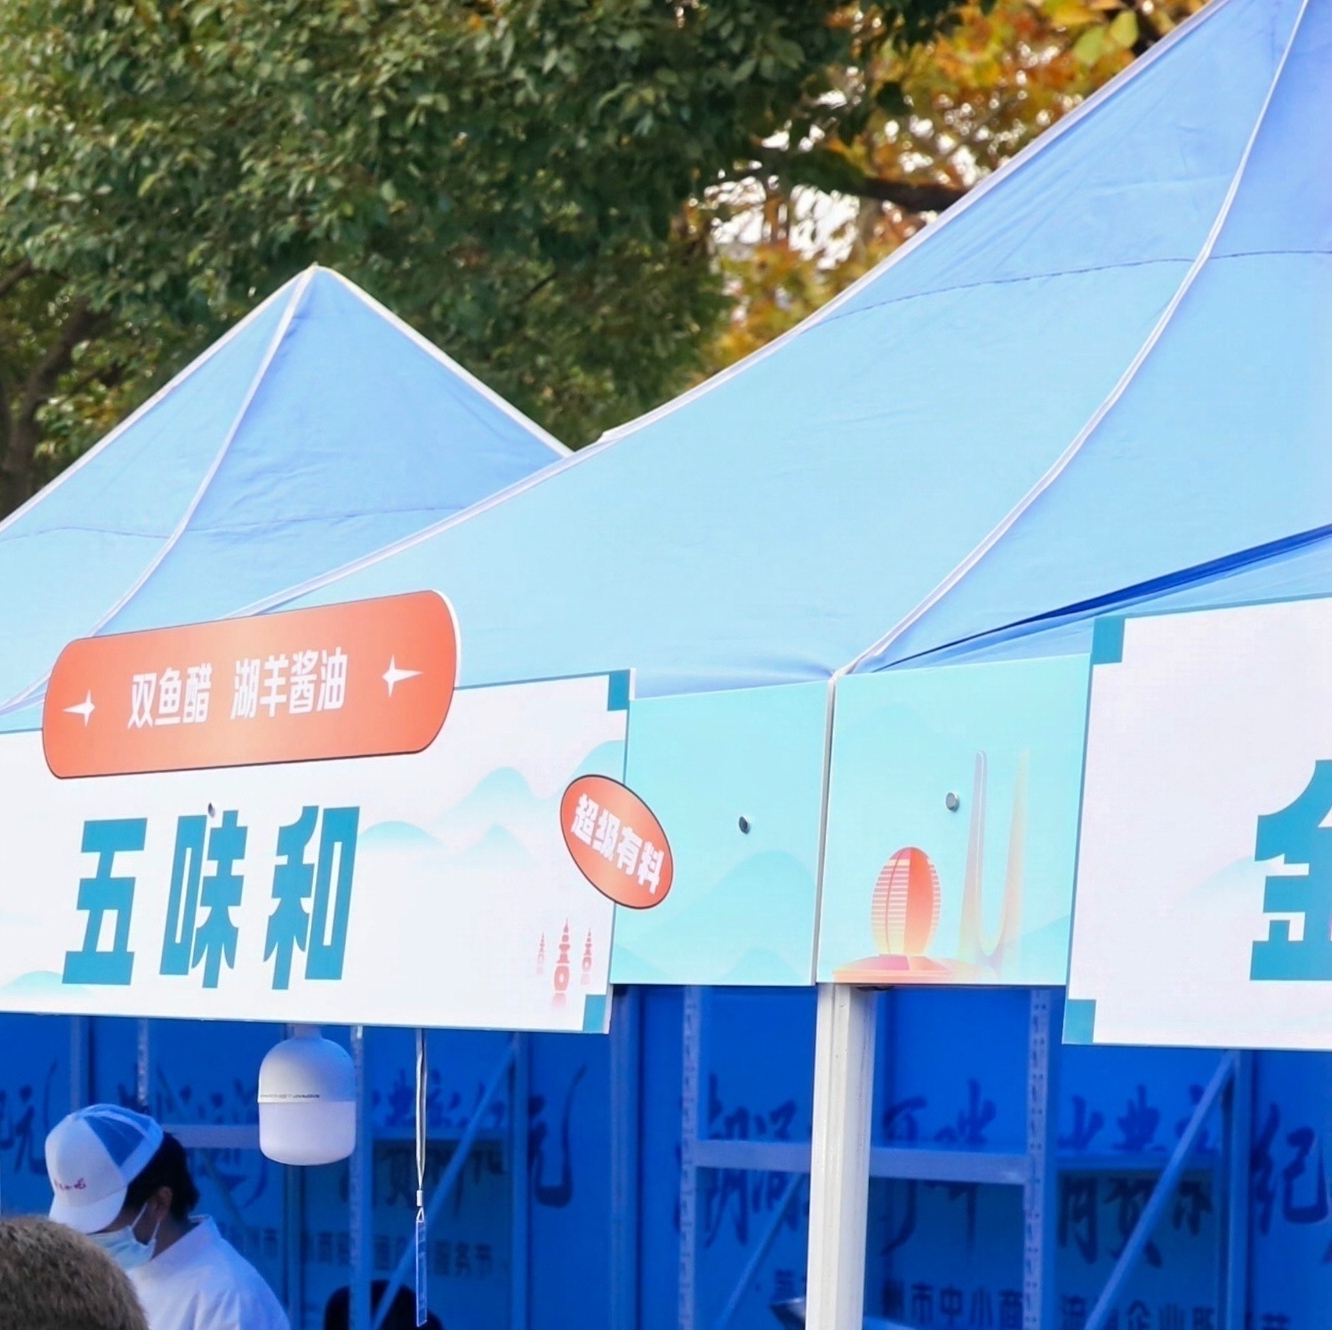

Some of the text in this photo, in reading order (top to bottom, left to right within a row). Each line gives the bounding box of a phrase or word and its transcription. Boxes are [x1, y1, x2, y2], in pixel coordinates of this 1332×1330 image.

[128, 646, 348, 729] 双鱼醋 湖羊酱油
[570, 793, 664, 894] 超级有料
[62, 805, 360, 990] 五味和
